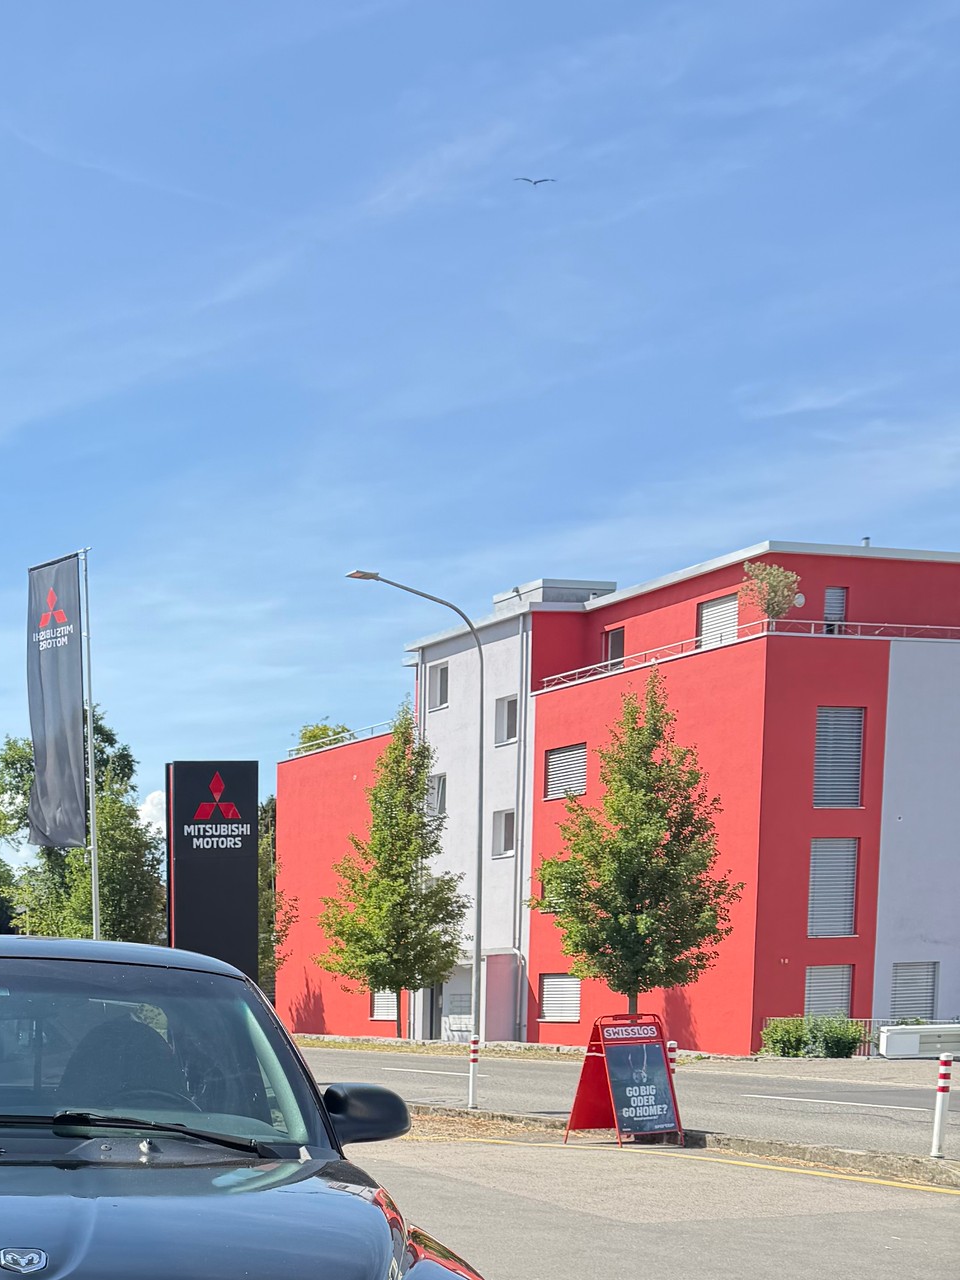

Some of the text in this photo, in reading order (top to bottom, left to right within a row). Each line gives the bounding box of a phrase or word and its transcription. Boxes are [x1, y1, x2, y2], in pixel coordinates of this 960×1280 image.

[183, 824, 251, 836] MITSUBISHI
[192, 837, 242, 849] MOTORS
[605, 1027, 656, 1038] SWISSLOS
[626, 1085, 656, 1097] GO BIG
[631, 1095, 655, 1107] ODER
[622, 1104, 668, 1117] GO HOME?
